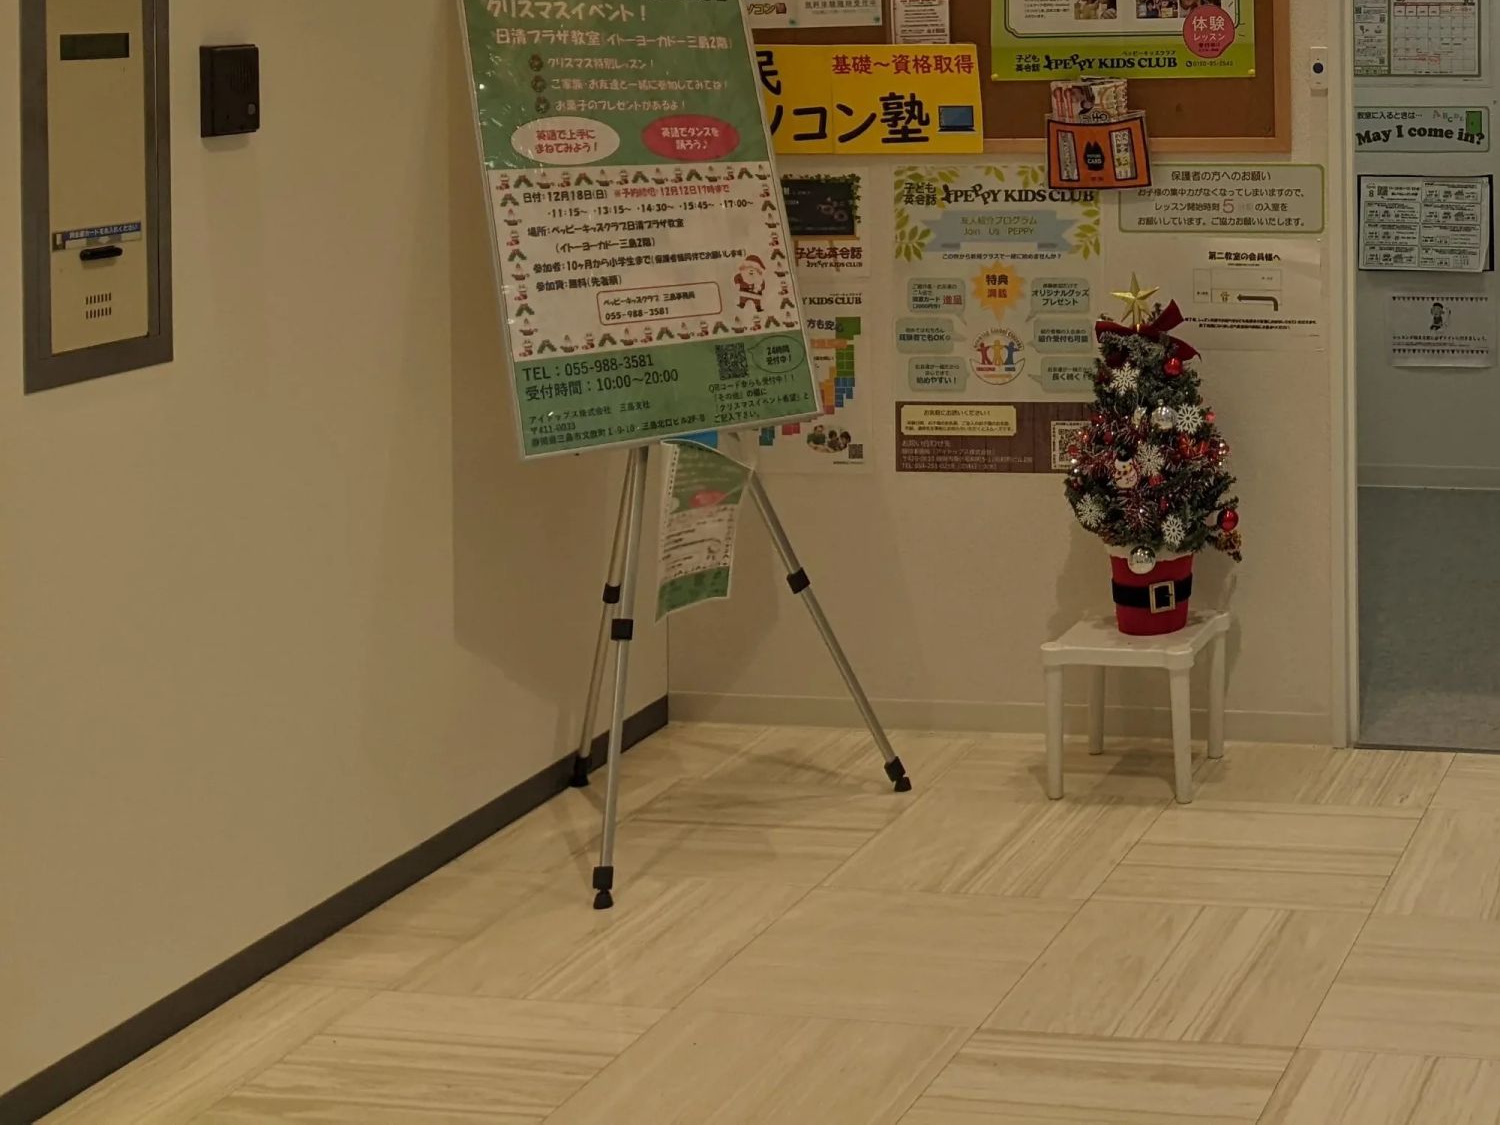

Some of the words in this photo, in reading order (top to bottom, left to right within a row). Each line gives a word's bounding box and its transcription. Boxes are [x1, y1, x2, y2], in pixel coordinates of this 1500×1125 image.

[1191, 15, 1226, 33] 体験
[1193, 32, 1226, 42] レッスン
[832, 53, 976, 76] 基礎〜資格取得
[1015, 53, 1041, 63] 子ども
[1054, 52, 1099, 72] PEPPY
[1100, 57, 1136, 70] KIDS
[1137, 55, 1178, 69] CLUB
[1015, 62, 1041, 73] 英会話
[1355, 128, 1393, 147] May
[1395, 124, 1405, 138] I
[1407, 126, 1454, 139] come
[1456, 127, 1486, 145] in?
[1171, 170, 1272, 182] 保護者の方へのお願い
[903, 181, 937, 194] 子ども
[952, 182, 1002, 206] PEPPY
[1004, 188, 1047, 203] KIDS
[1048, 189, 1095, 203] CLUB
[903, 193, 937, 206] 英会話
[1222, 198, 1235, 214] 5
[1254, 202, 1289, 212] の入室を
[962, 226, 981, 236] Join
[988, 226, 1000, 236] Us
[1007, 226, 1034, 236] PEPPY
[796, 246, 863, 261] 子ども英会話
[985, 273, 1009, 286] 特典
[1031, 289, 1090, 298] オリジナルグッズ
[809, 296, 834, 306] KIDS
[834, 295, 863, 306] CLUB
[1042, 297, 1079, 307] プレゼント
[605, 306, 670, 322] 055-988-3581
